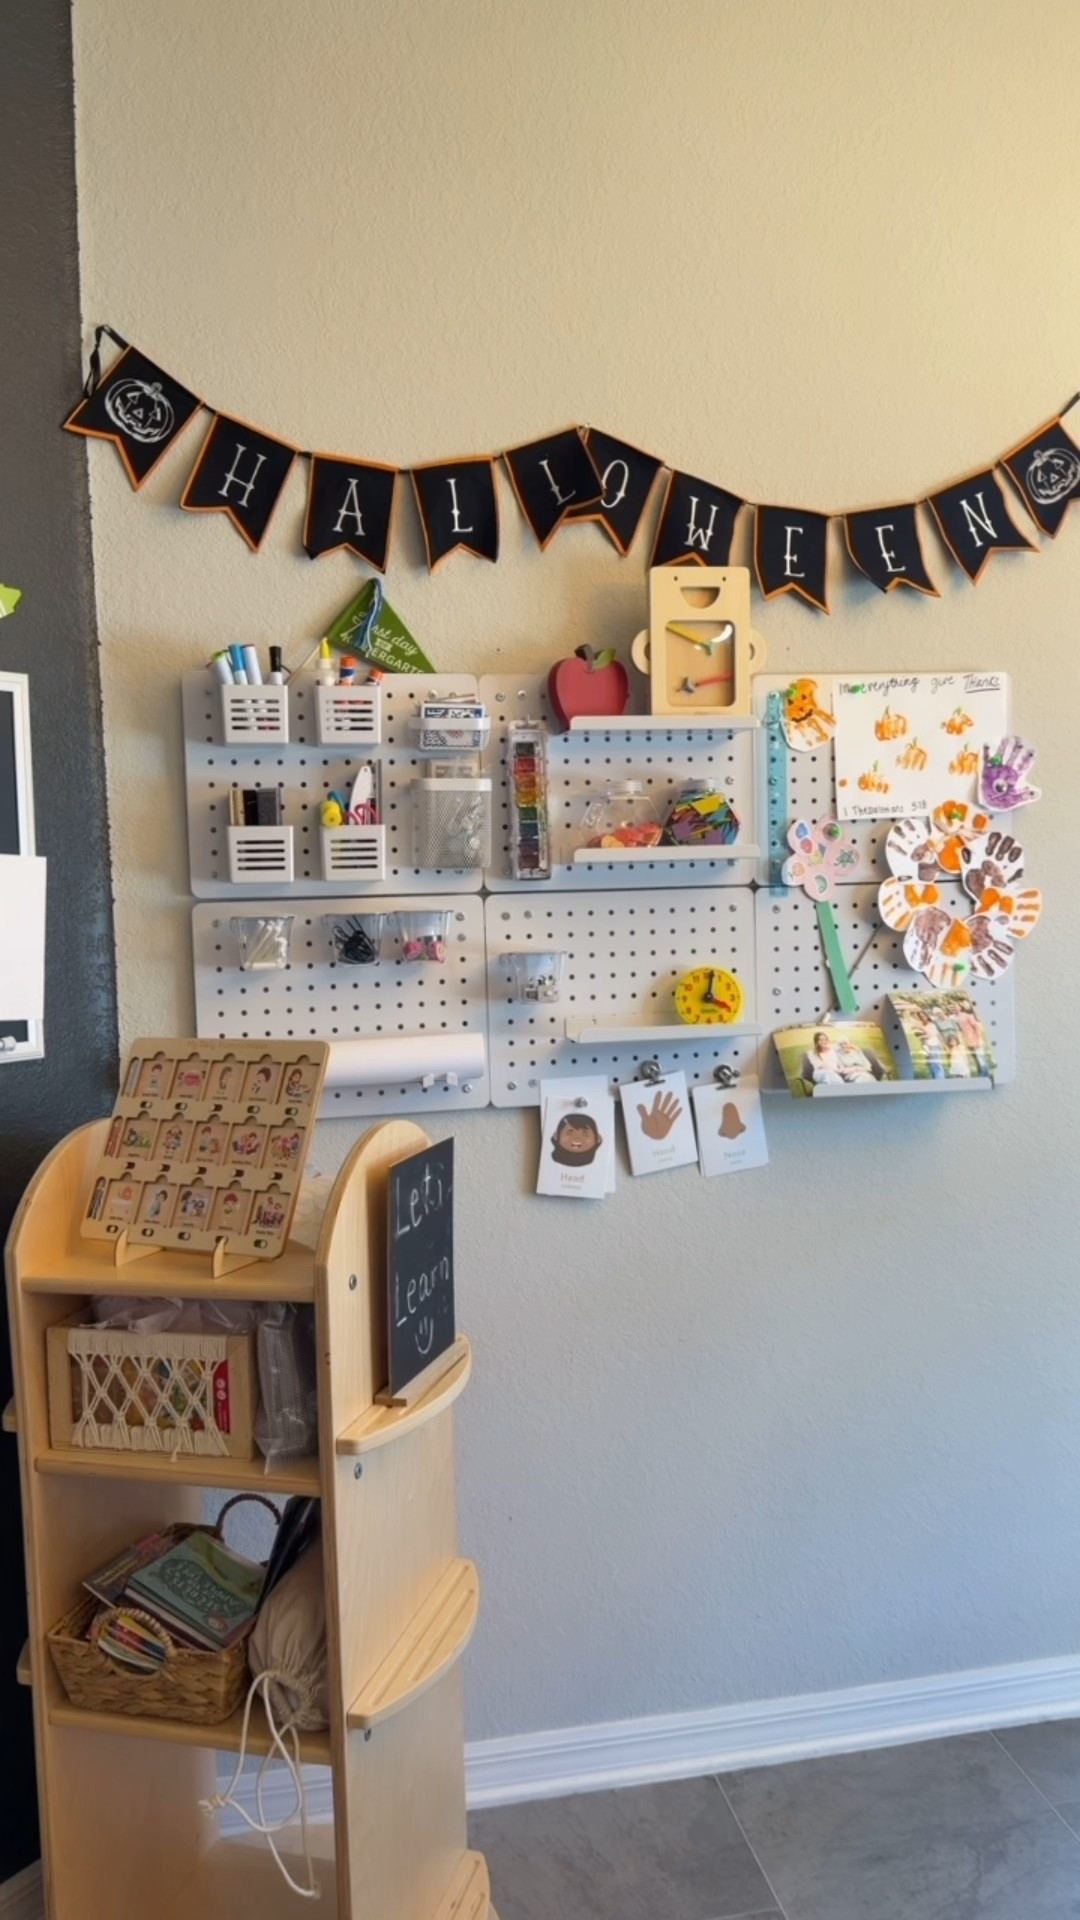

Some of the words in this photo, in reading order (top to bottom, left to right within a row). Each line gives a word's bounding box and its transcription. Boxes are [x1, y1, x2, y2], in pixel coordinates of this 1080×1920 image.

[222, 443, 999, 578] HALLOWEEN
[391, 636, 418, 656] day
[930, 676, 955, 695] give
[652, 1145, 675, 1157] Hand
[723, 1149, 746, 1160] Nose
[560, 1172, 585, 1183] Head
[396, 1256, 449, 1327] Learn
